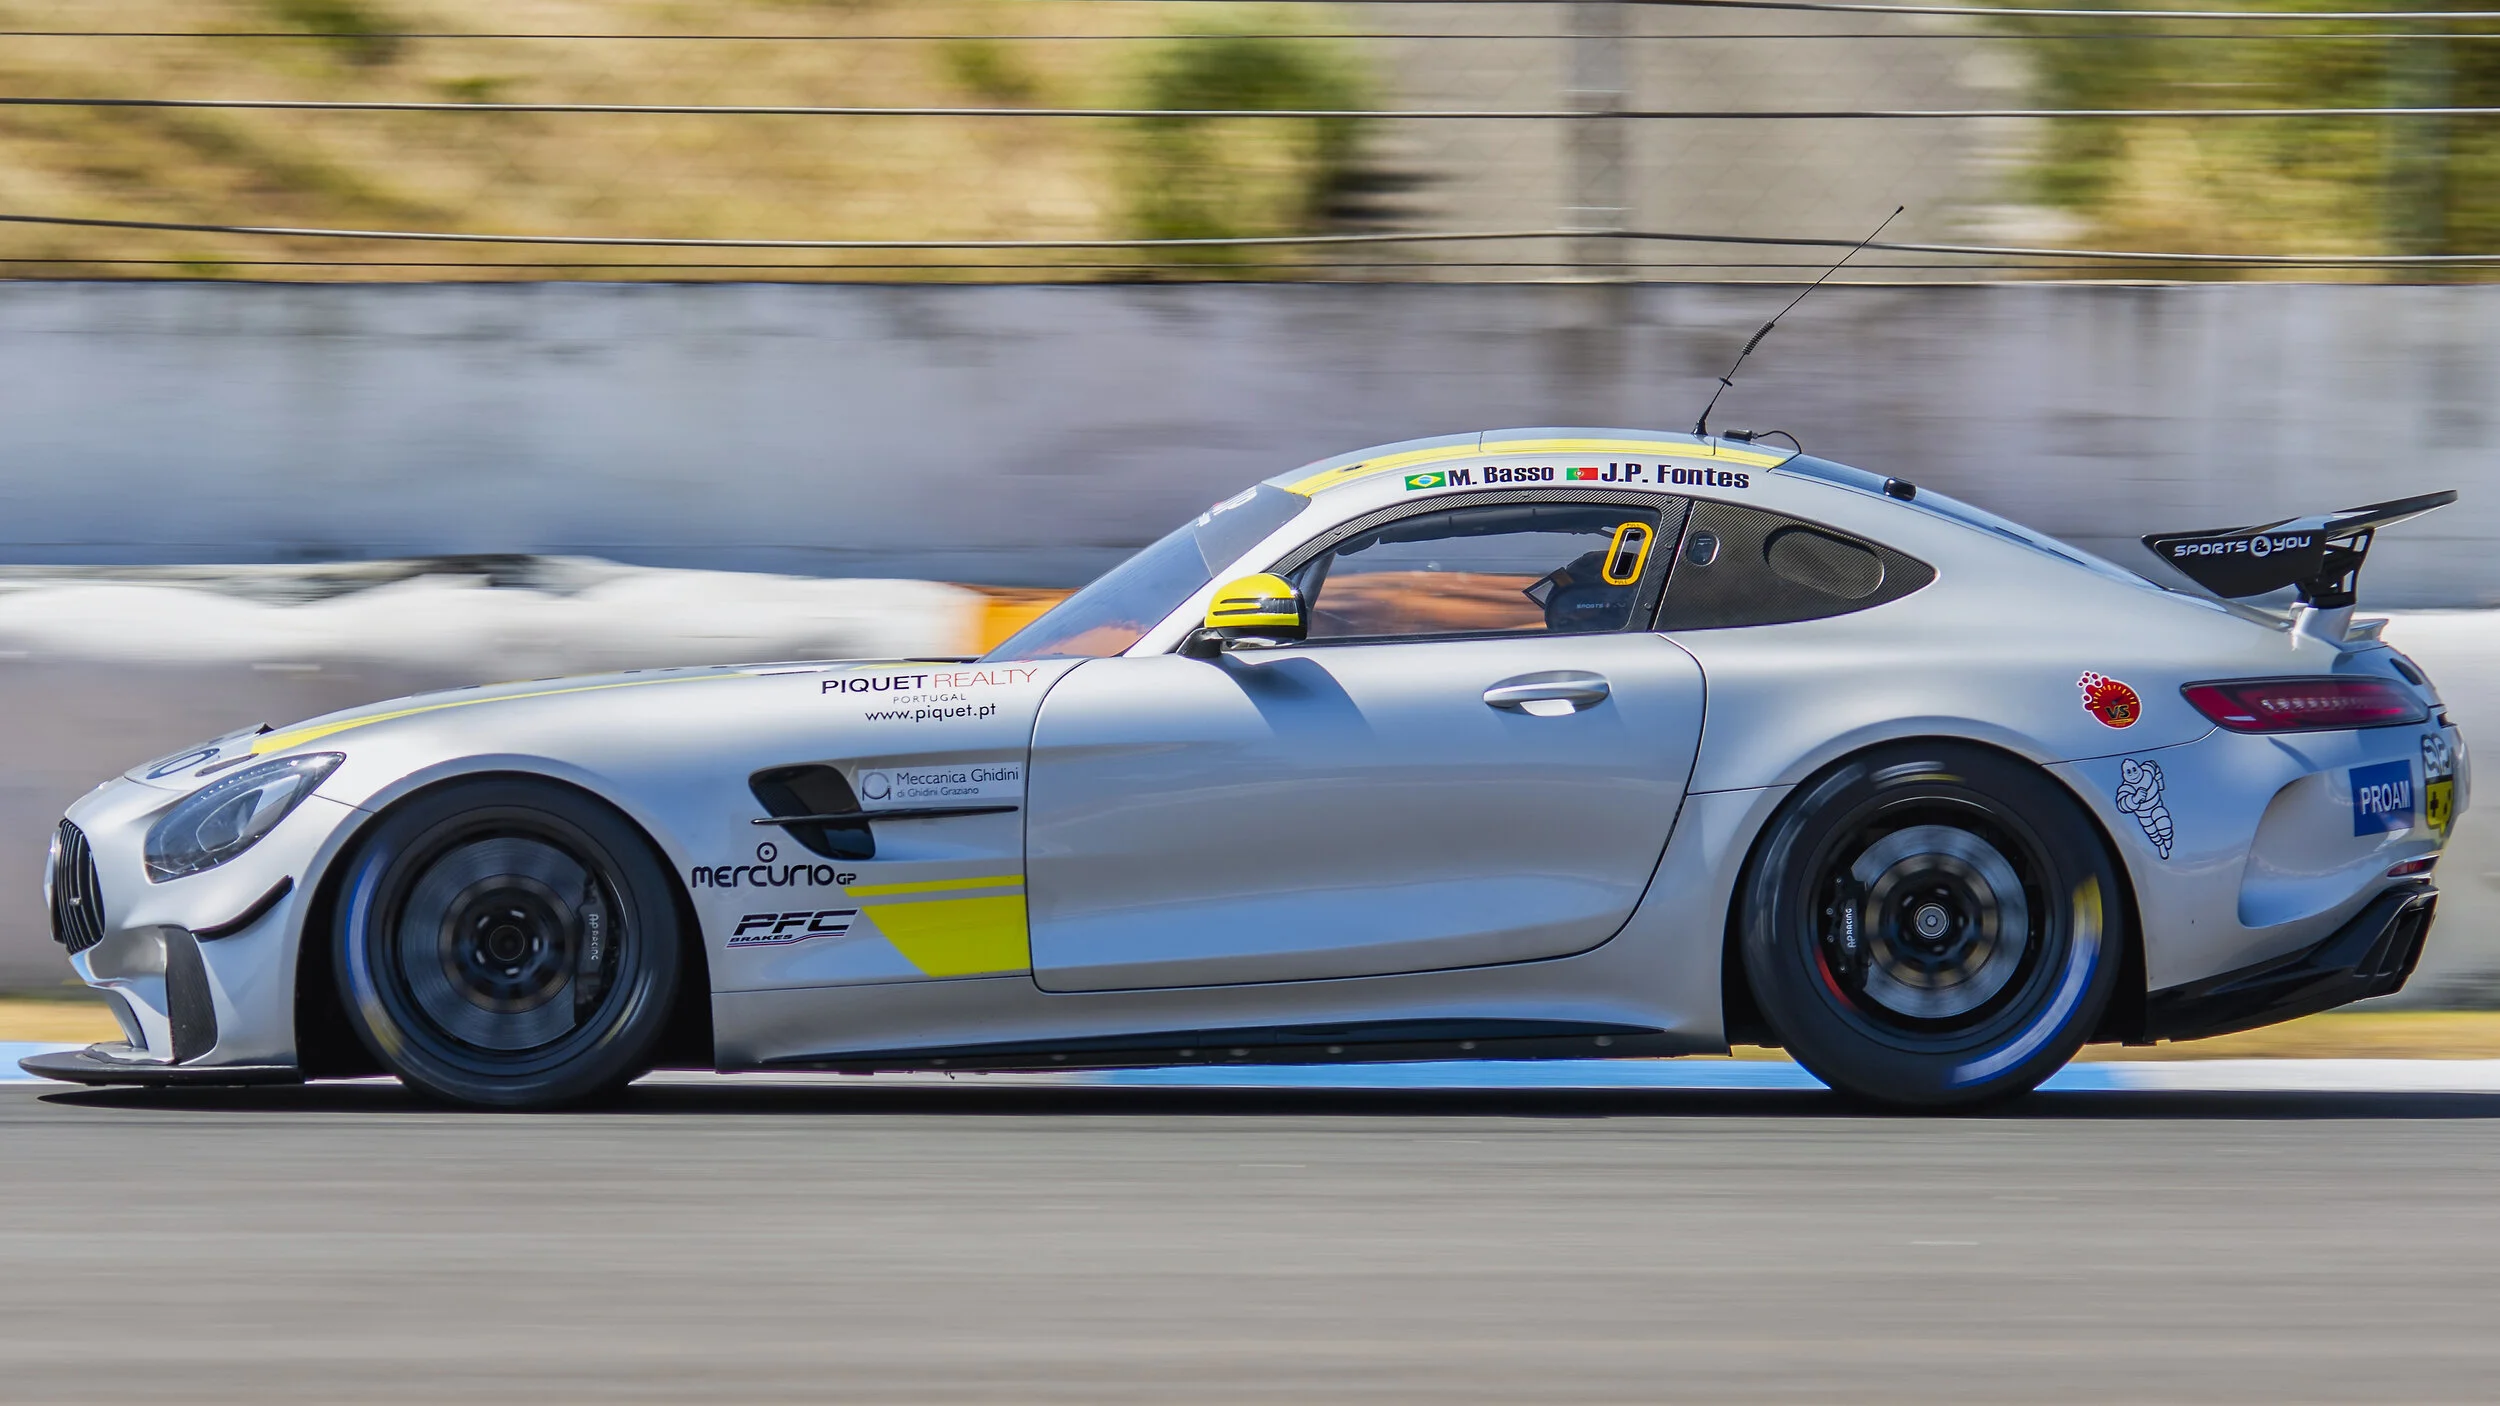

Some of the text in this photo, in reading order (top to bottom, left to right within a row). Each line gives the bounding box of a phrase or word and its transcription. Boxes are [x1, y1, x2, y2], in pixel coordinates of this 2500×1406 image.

[1448, 466, 1554, 487] M. Basso
[1601, 462, 1749, 489] J.P. Fontes
[821, 667, 1038, 695] PIQUET REALTY
[892, 692, 967, 704] PORTUGAL
[864, 702, 996, 723] www.piquet.pt
[2105, 704, 2130, 720] VS
[896, 766, 1020, 786] Meccanica Ghidini
[896, 785, 980, 799] di Ghidini Graziano
[2360, 780, 2411, 815] PROAM
[732, 909, 859, 936] PFC
[729, 934, 794, 943] BRAKES
